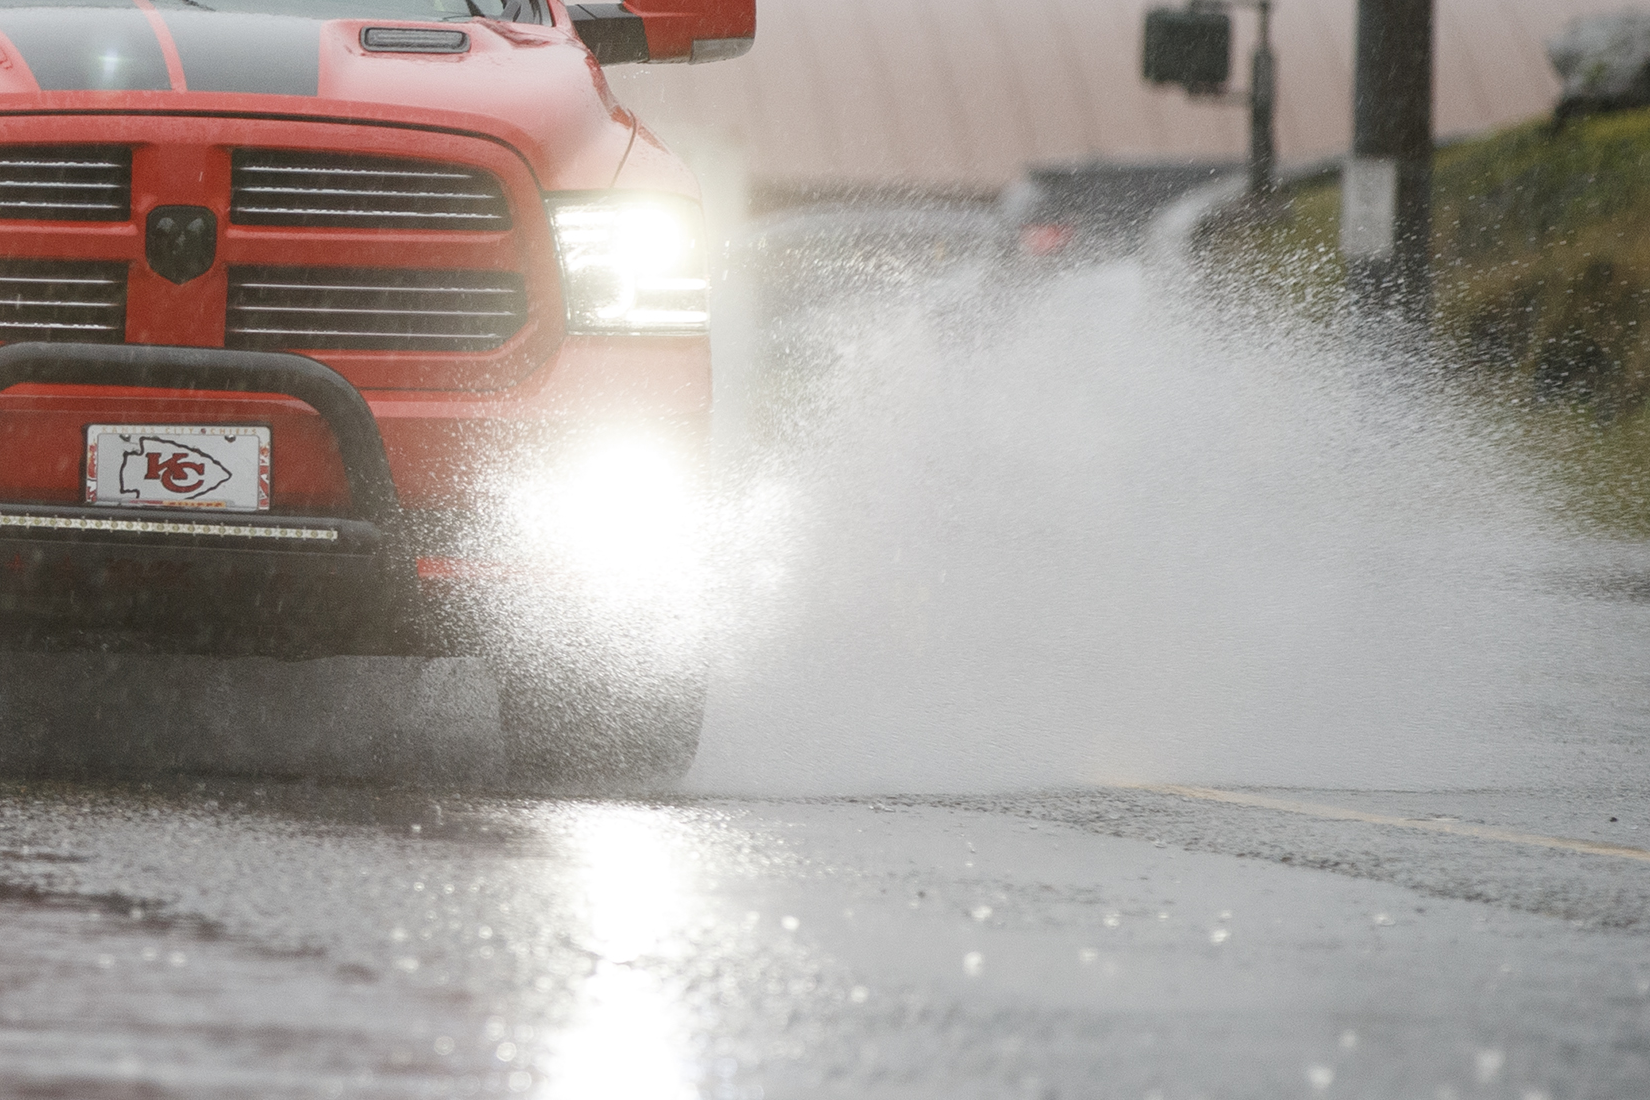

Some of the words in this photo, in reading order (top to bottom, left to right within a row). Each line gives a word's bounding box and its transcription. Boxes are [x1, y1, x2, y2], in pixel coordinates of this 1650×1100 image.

[102, 426, 156, 434] KANSAS
[165, 427, 195, 435] CITY
[210, 427, 258, 435] CHIEFS
[143, 452, 206, 494] KC
